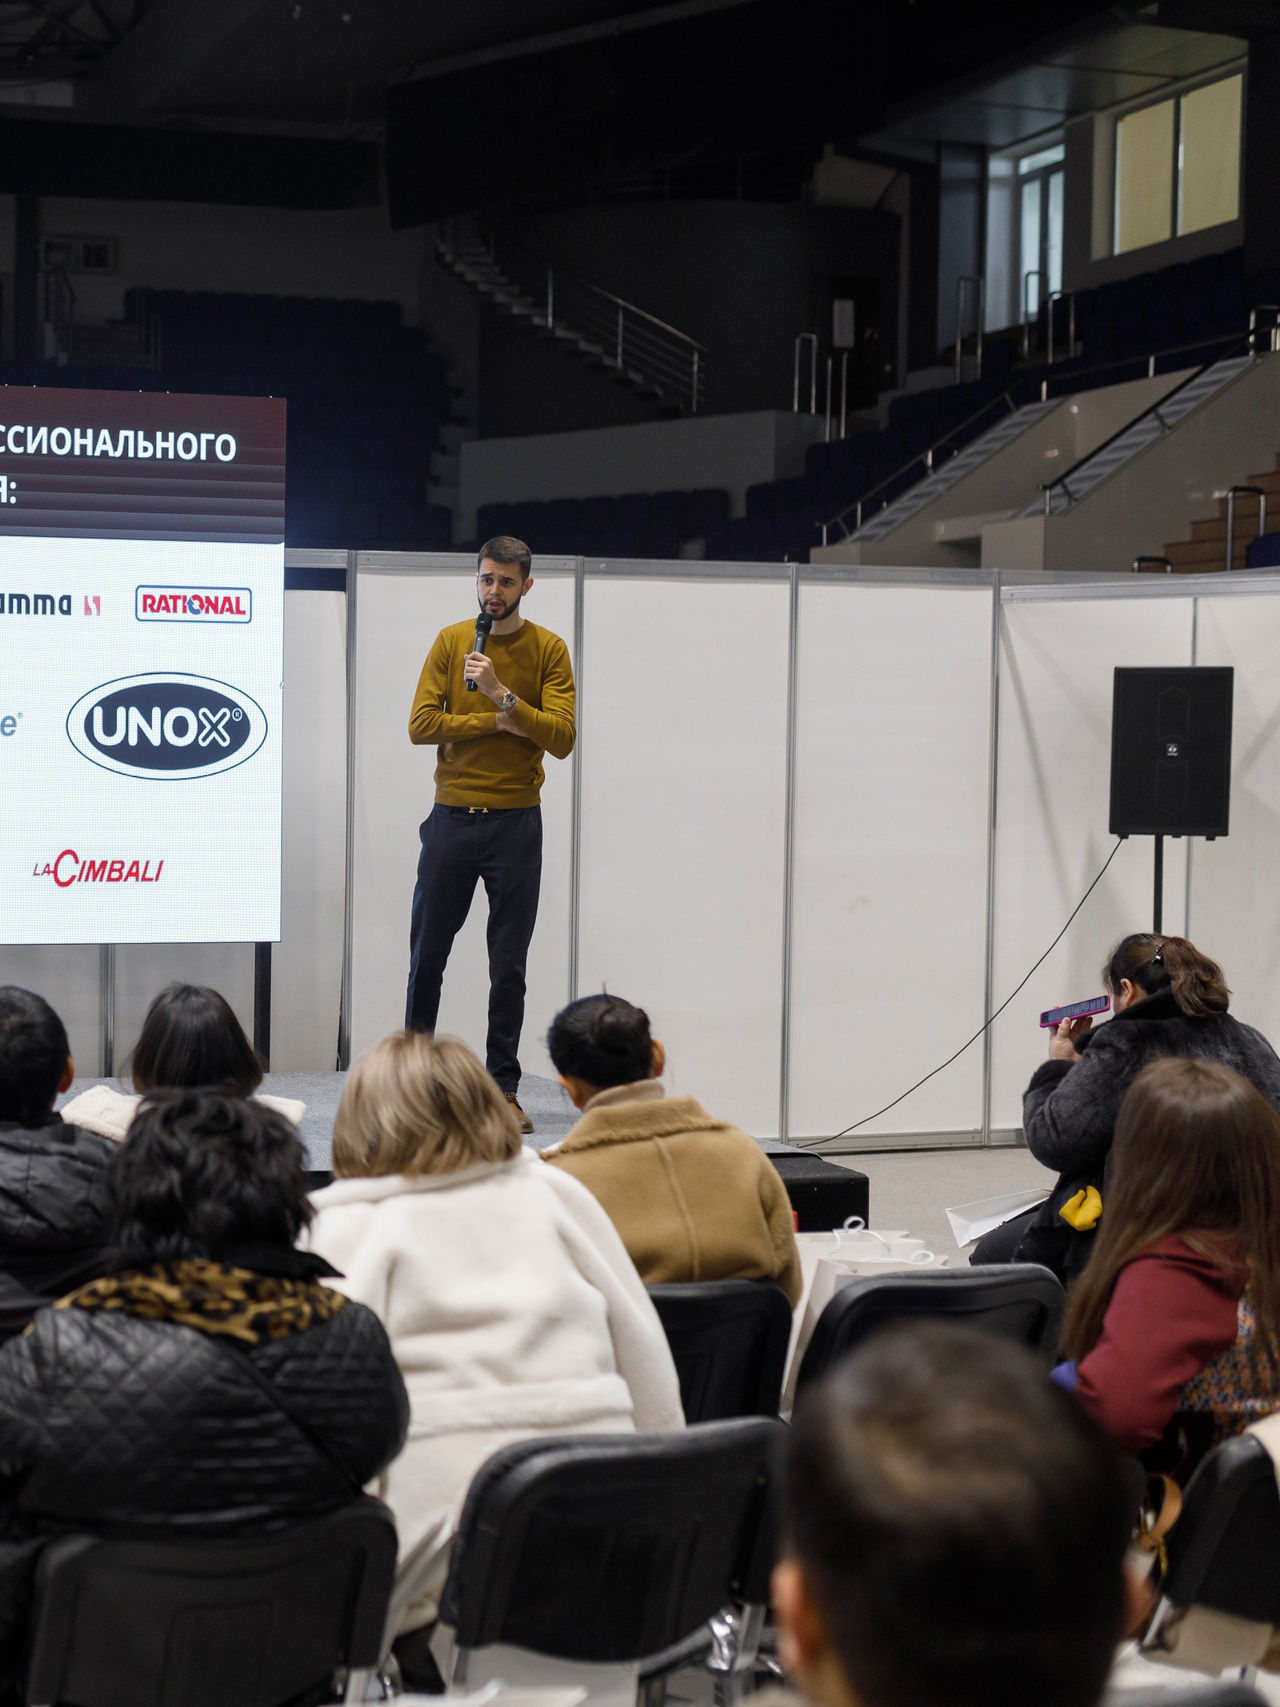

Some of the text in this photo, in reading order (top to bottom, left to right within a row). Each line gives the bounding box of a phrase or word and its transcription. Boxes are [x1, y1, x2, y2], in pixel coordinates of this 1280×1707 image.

[142, 593, 247, 617] RATIONAL
[32, 848, 165, 888] LA CIMBALI
